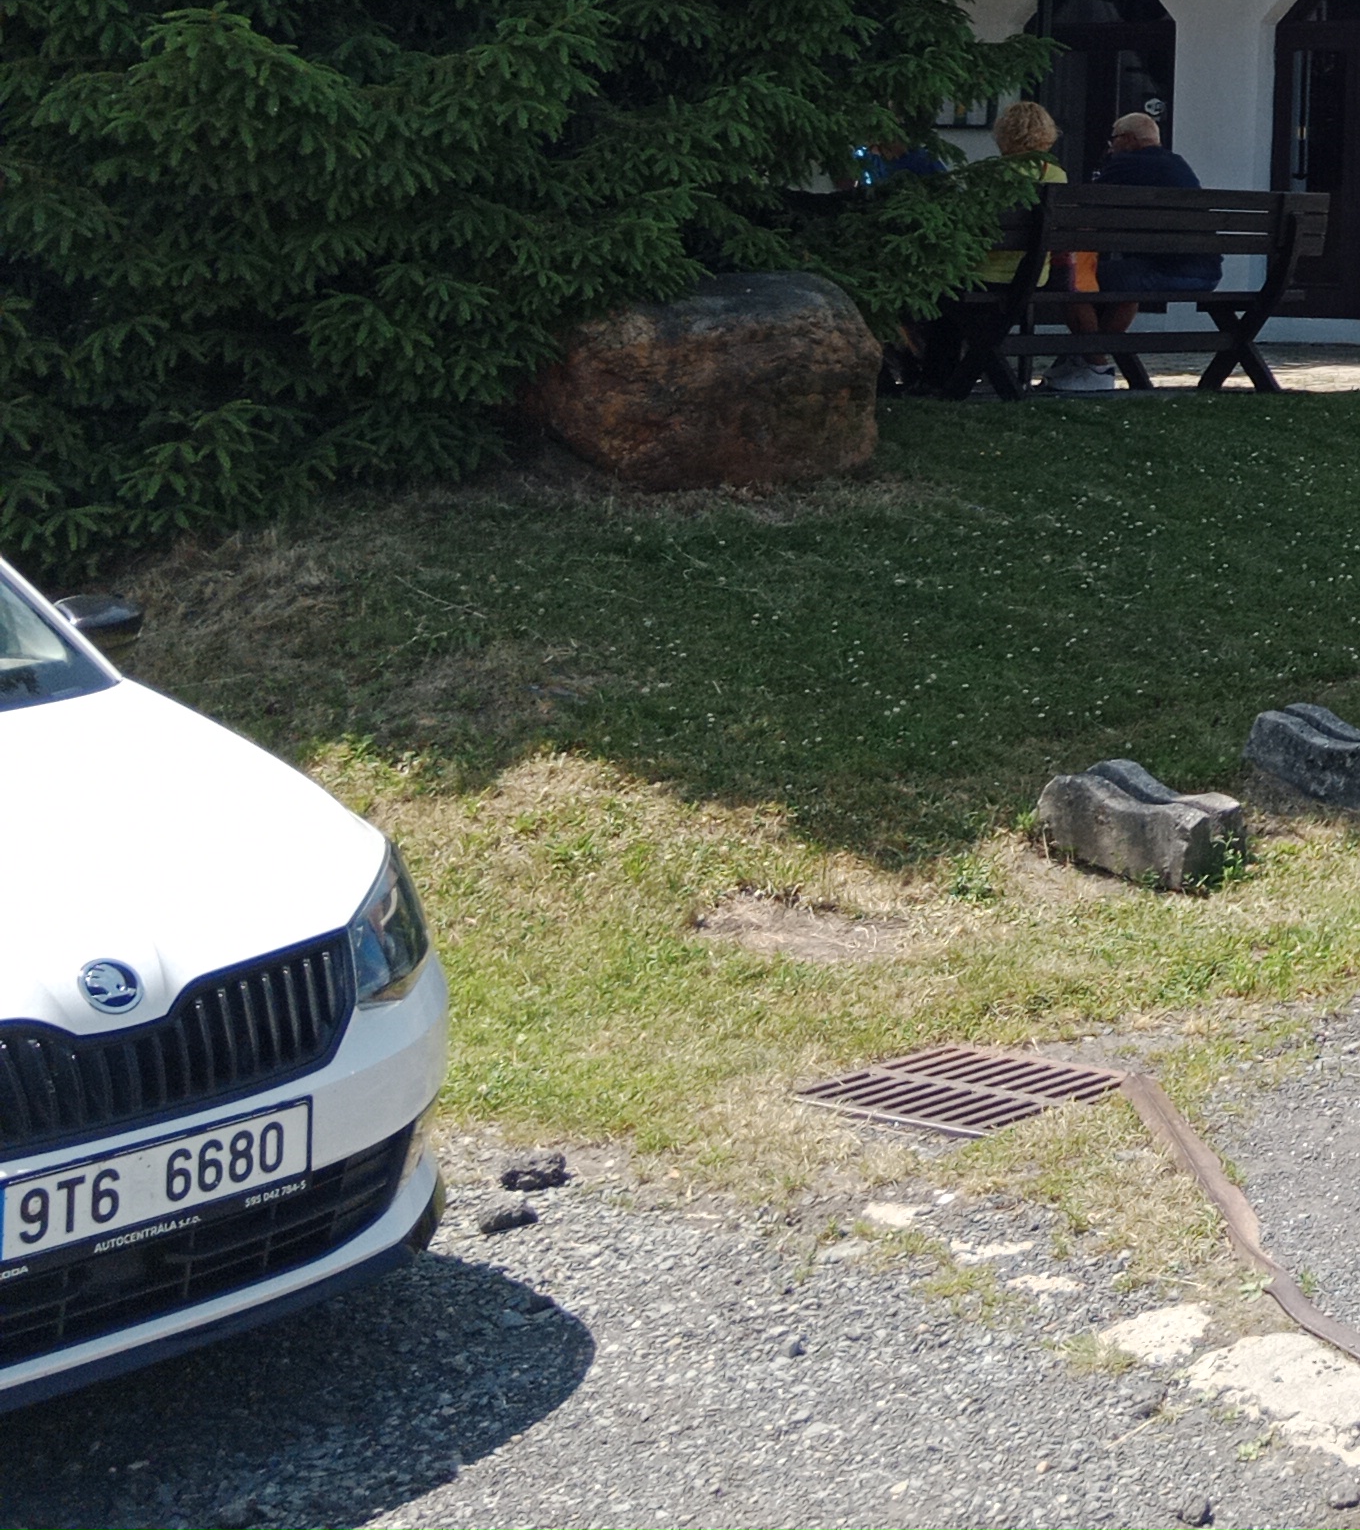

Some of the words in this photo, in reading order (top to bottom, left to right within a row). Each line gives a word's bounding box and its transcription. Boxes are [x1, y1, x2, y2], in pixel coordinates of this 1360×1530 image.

[19, 1168, 120, 1244] 9T6
[166, 1121, 284, 1202] 6680
[0, 1265, 29, 1281] ODA
